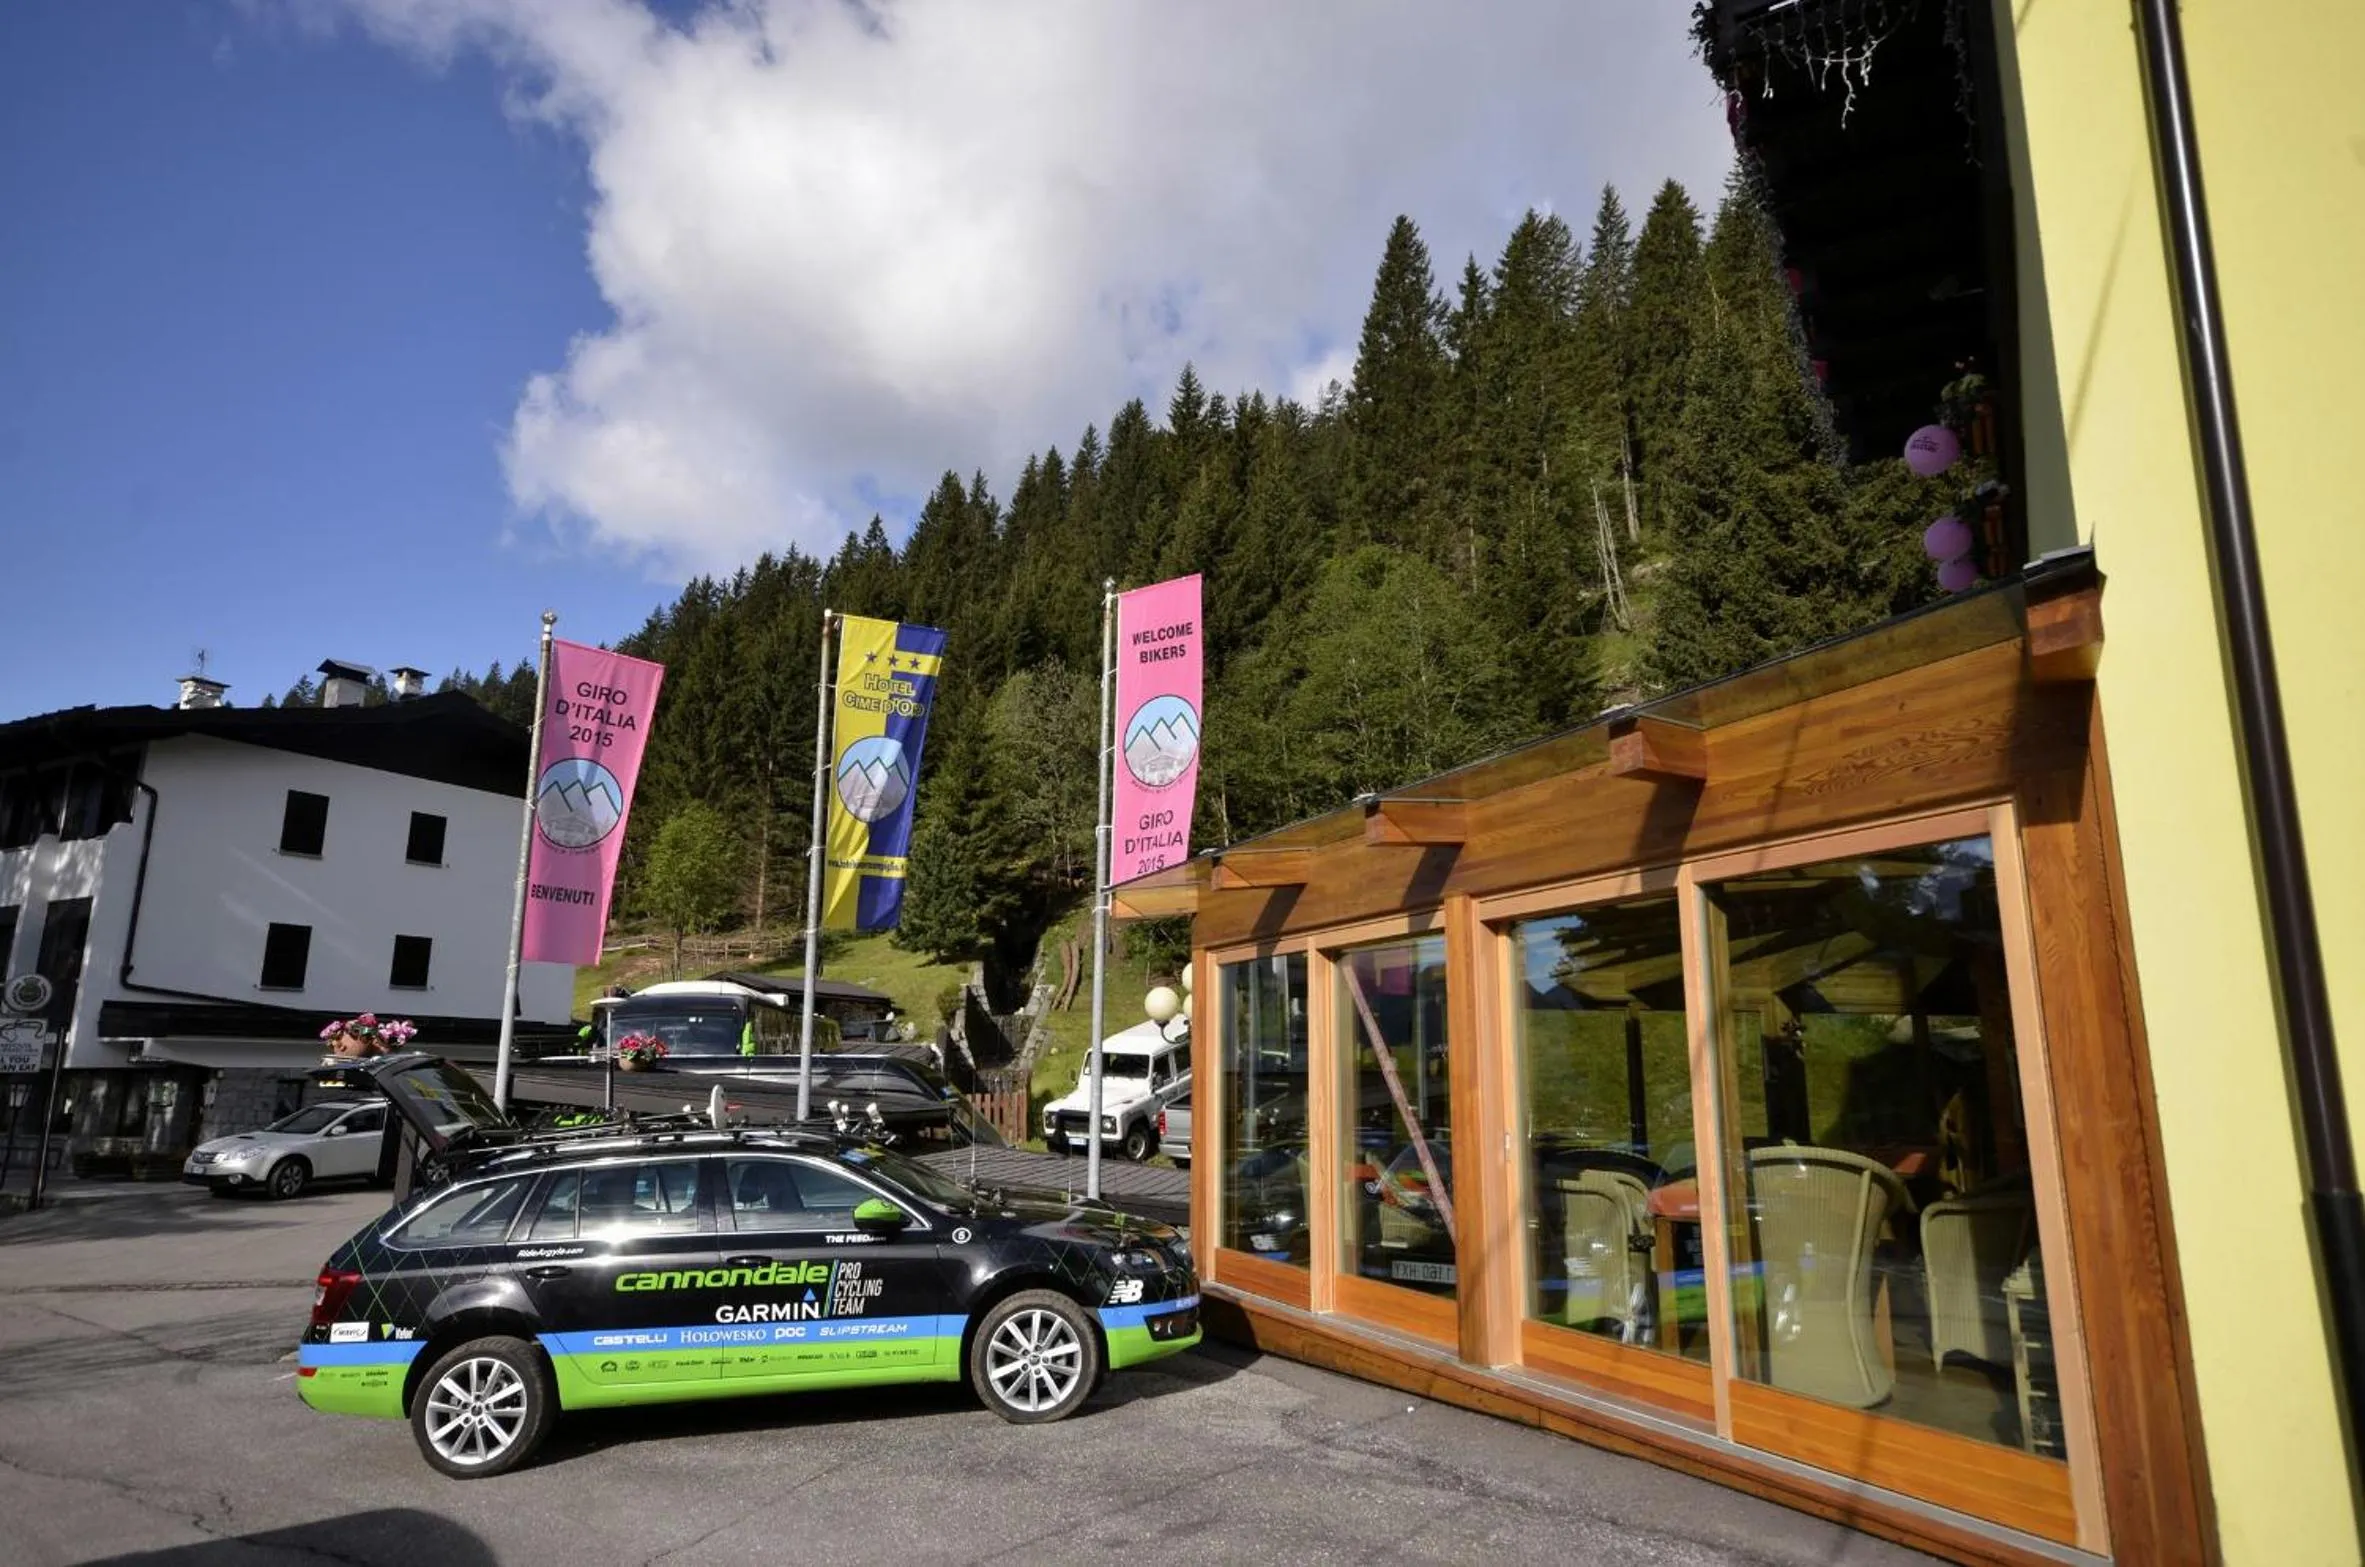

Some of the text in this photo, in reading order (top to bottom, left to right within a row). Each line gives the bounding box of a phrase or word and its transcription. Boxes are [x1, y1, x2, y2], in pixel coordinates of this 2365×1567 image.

[1132, 622, 1193, 645] WELCOME
[1139, 644, 1186, 663] BIKERS
[577, 681, 627, 705] GIRO
[864, 672, 916, 697] HOTEL
[842, 690, 881, 712] CIME
[555, 699, 636, 731] D'ITALIA
[569, 725, 614, 747] 2015
[1139, 810, 1173, 830] GIRO
[1125, 831, 1183, 855] D'ITALIA
[1137, 854, 1165, 874] 2015
[825, 1234, 845, 1243] THE
[614, 1262, 828, 1293] cannondale
[837, 1261, 862, 1280] PRO
[834, 1278, 883, 1298] CYCLING
[715, 1301, 820, 1324] GARMIN
[832, 1297, 865, 1316] TEAM
[680, 1328, 767, 1343] HOLOWESKO
[819, 1322, 909, 1337] SLIPSTREAM
